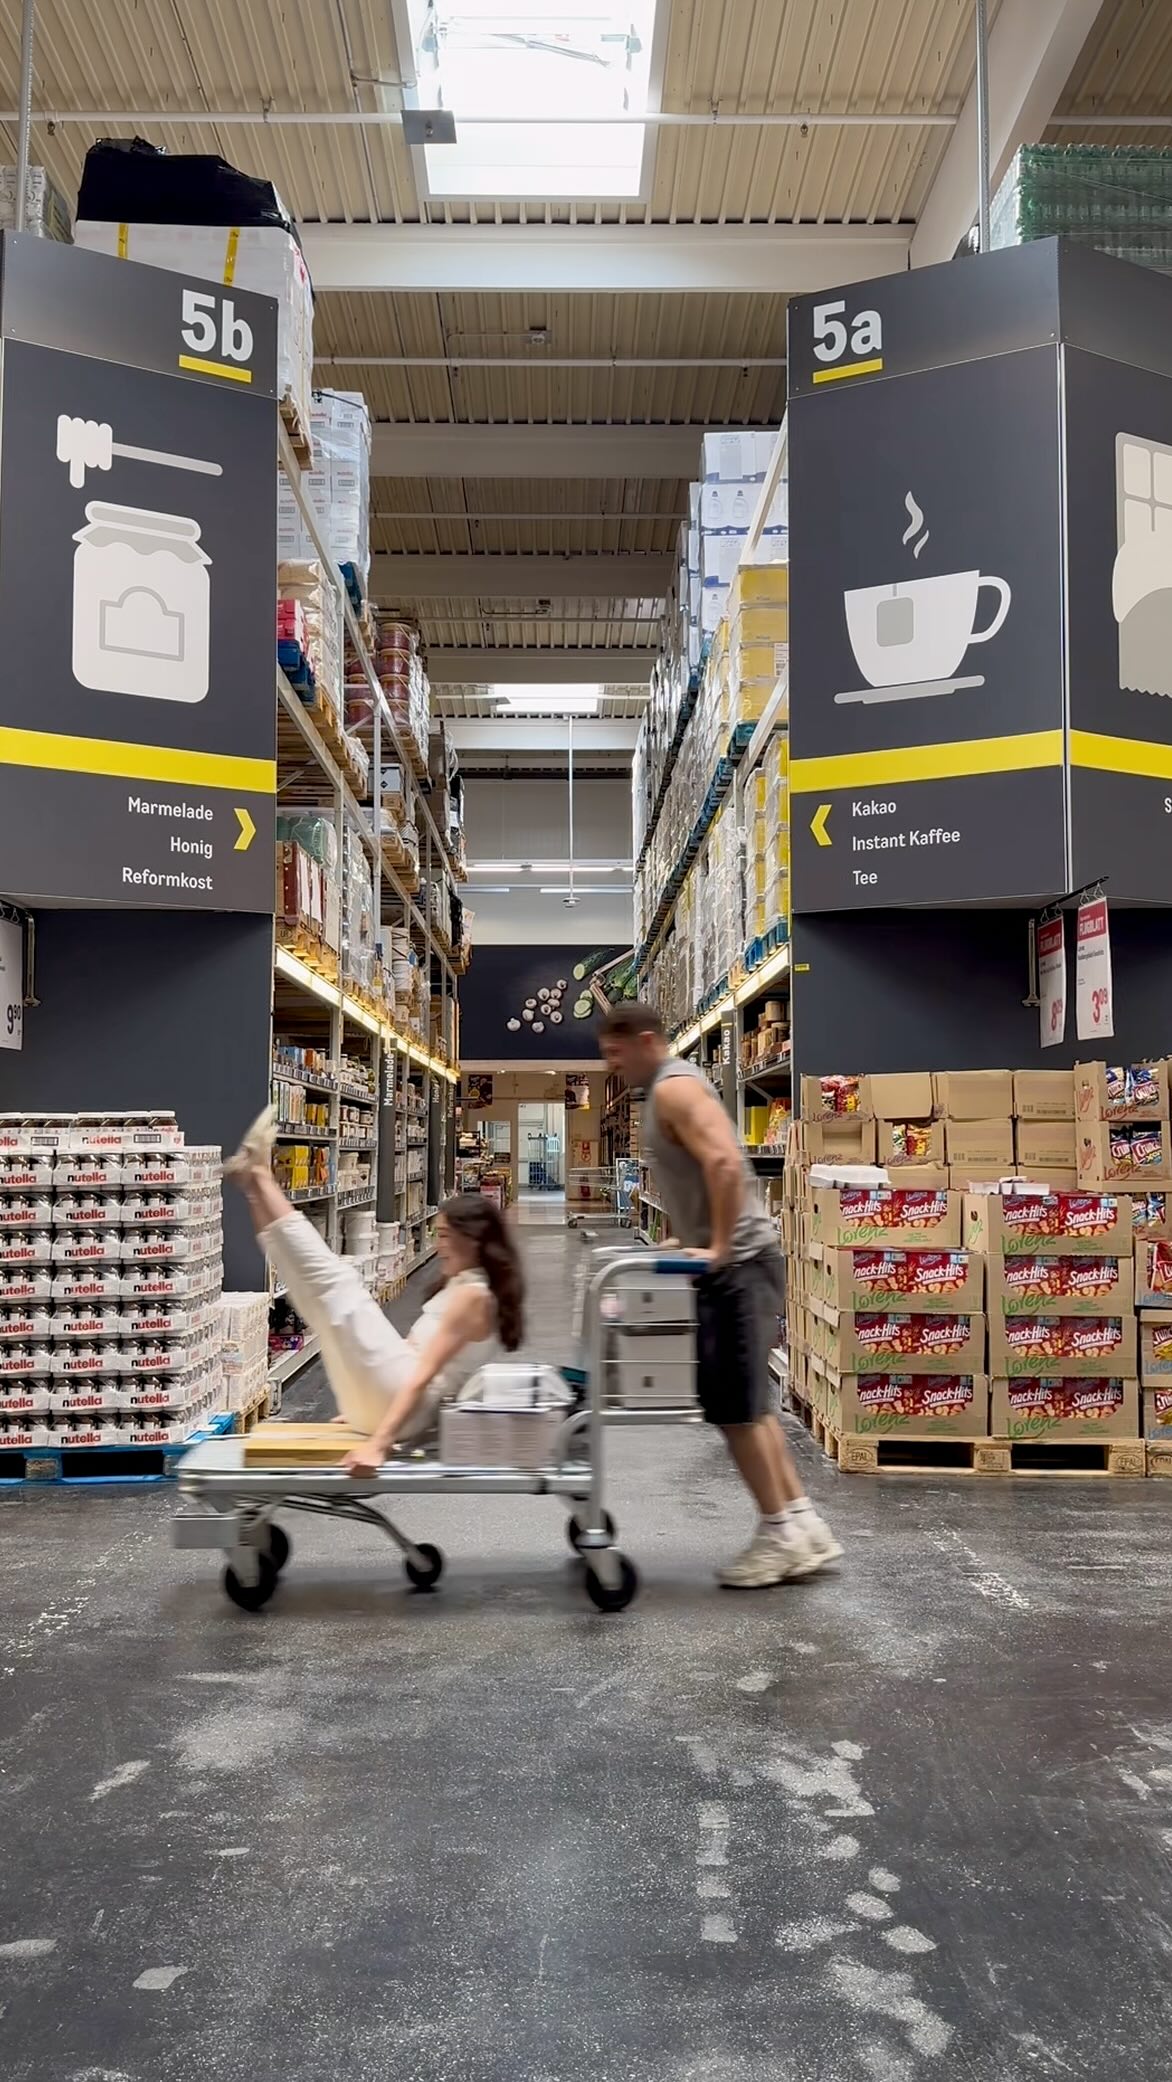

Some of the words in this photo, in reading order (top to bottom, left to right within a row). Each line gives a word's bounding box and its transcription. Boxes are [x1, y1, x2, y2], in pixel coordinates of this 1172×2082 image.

[181, 289, 253, 361] 5b
[813, 300, 882, 362] 5a
[128, 796, 213, 821] Marmelade
[852, 800, 897, 817] Kakao
[170, 836, 213, 859] Honig
[852, 833, 906, 851] Instant
[909, 828, 961, 846] Kaffee
[122, 867, 213, 890] Reformkost
[852, 870, 878, 885] Tee
[722, 1029, 731, 1065] Kakao
[383, 1054, 395, 1106] Marmelade
[1101, 1104, 1139, 1120] Lorenz
[82, 1135, 121, 1146] nutella
[67, 1172, 107, 1183] nutella
[134, 1169, 175, 1181] nutella
[1104, 1164, 1142, 1180] Lorenz
[66, 1208, 106, 1220] nutella
[134, 1206, 174, 1218] nutella
[837, 1226, 888, 1245] Lorenz
[64, 1246, 104, 1257] nutella
[133, 1243, 173, 1255] nutella
[1001, 1234, 1056, 1254] Lorenz
[64, 1283, 104, 1295] nutella
[133, 1281, 173, 1293] nutella
[852, 1290, 906, 1311] Lorenz
[1001, 1294, 1057, 1315] Lorenz
[63, 1320, 103, 1332] nutella
[131, 1318, 171, 1330] nutella
[63, 1358, 103, 1370] nutella
[131, 1356, 170, 1368] nutella
[852, 1352, 907, 1373] Lorenz
[1005, 1357, 1060, 1376] Lorenz
[62, 1396, 102, 1408] nutella
[130, 1393, 170, 1405] nutella
[855, 1414, 911, 1434] Lorenz
[1007, 1417, 1063, 1438] Lorenz
[61, 1432, 101, 1444] nutella
[130, 1430, 169, 1442] nutella
